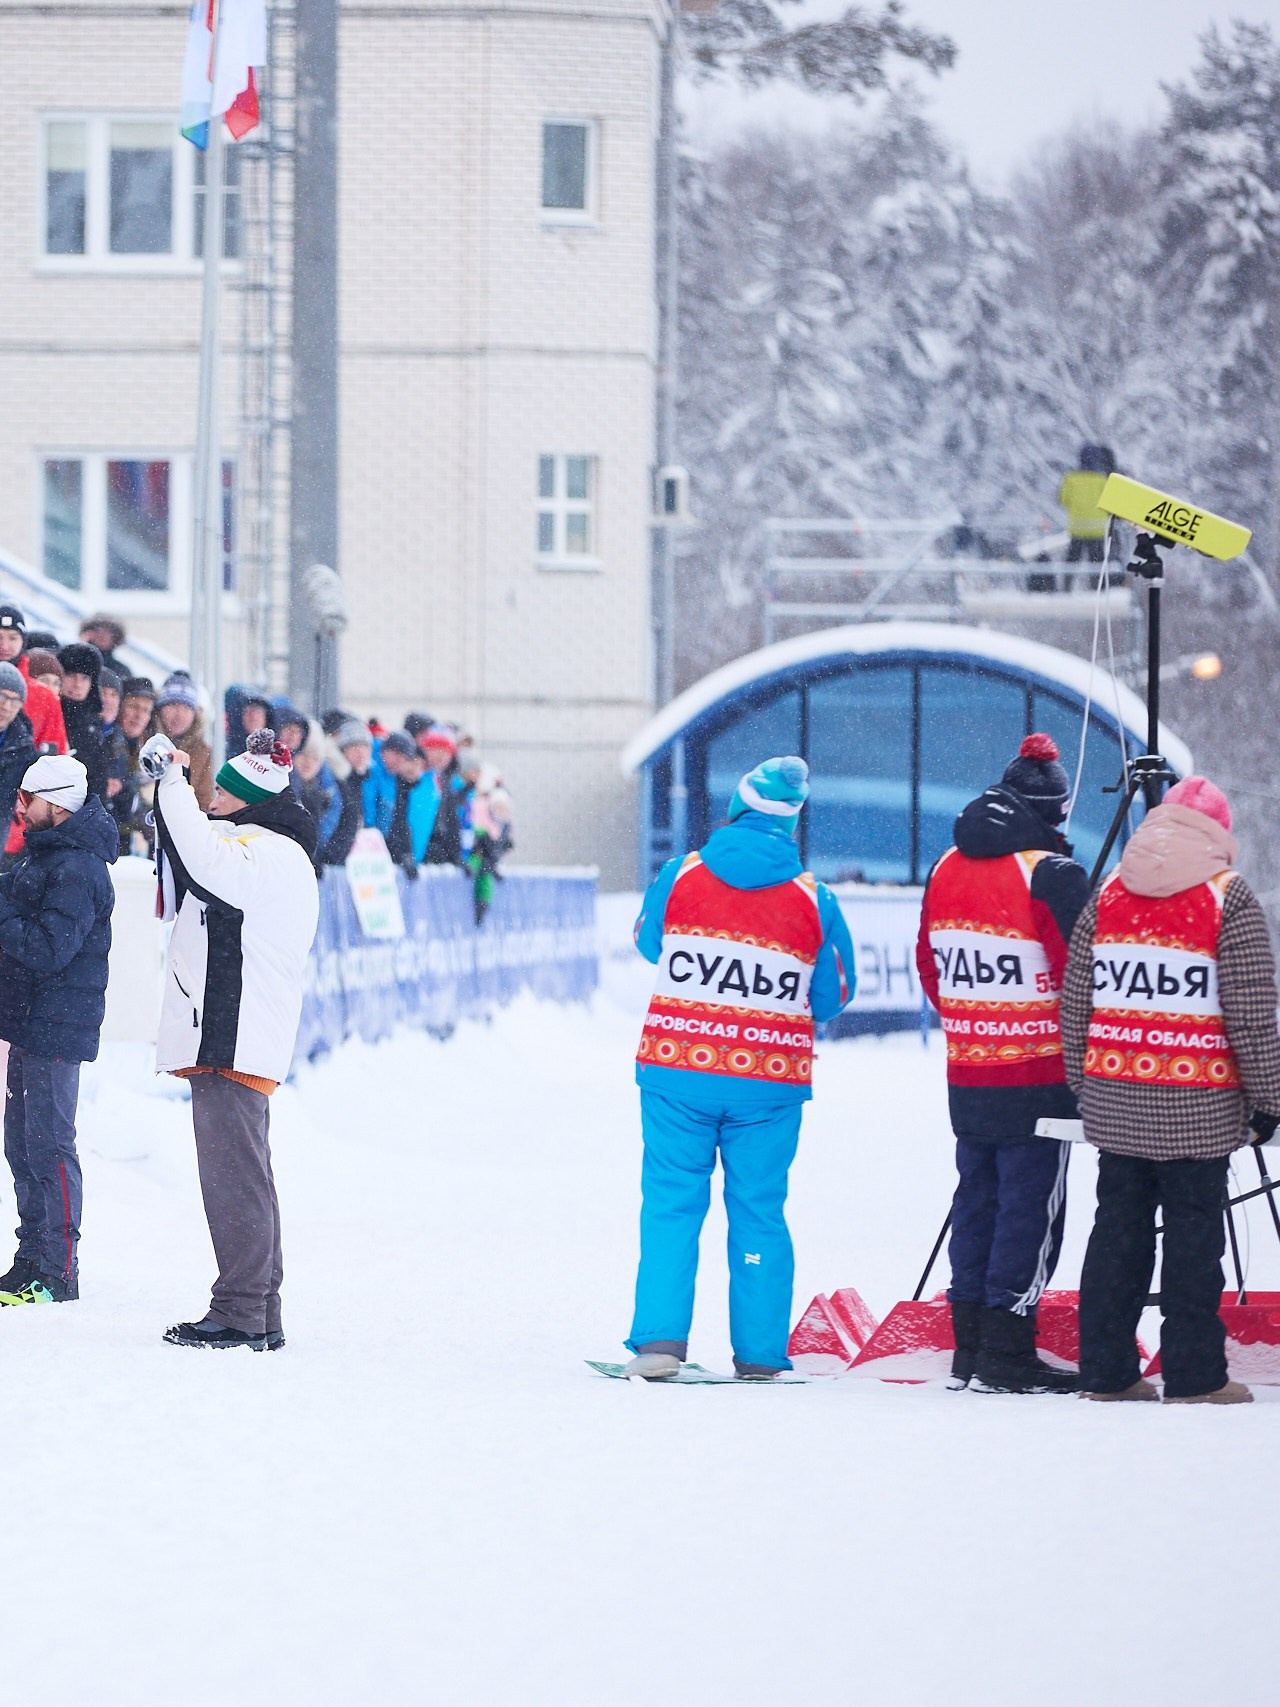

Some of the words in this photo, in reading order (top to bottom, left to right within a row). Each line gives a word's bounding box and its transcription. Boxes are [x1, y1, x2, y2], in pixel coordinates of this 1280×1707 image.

[1148, 501, 1203, 533] ALGE
[669, 950, 801, 1001] СУДЬЯ
[1092, 959, 1209, 1000] СУДЬЯ
[644, 1012, 739, 1039] ИРОВСКАЯ
[743, 1027, 812, 1048] ОБЛАСТЬ
[974, 1019, 1059, 1036] ОБЛАСТЬ
[1147, 1030, 1230, 1050] ОБЛАСТЬ
